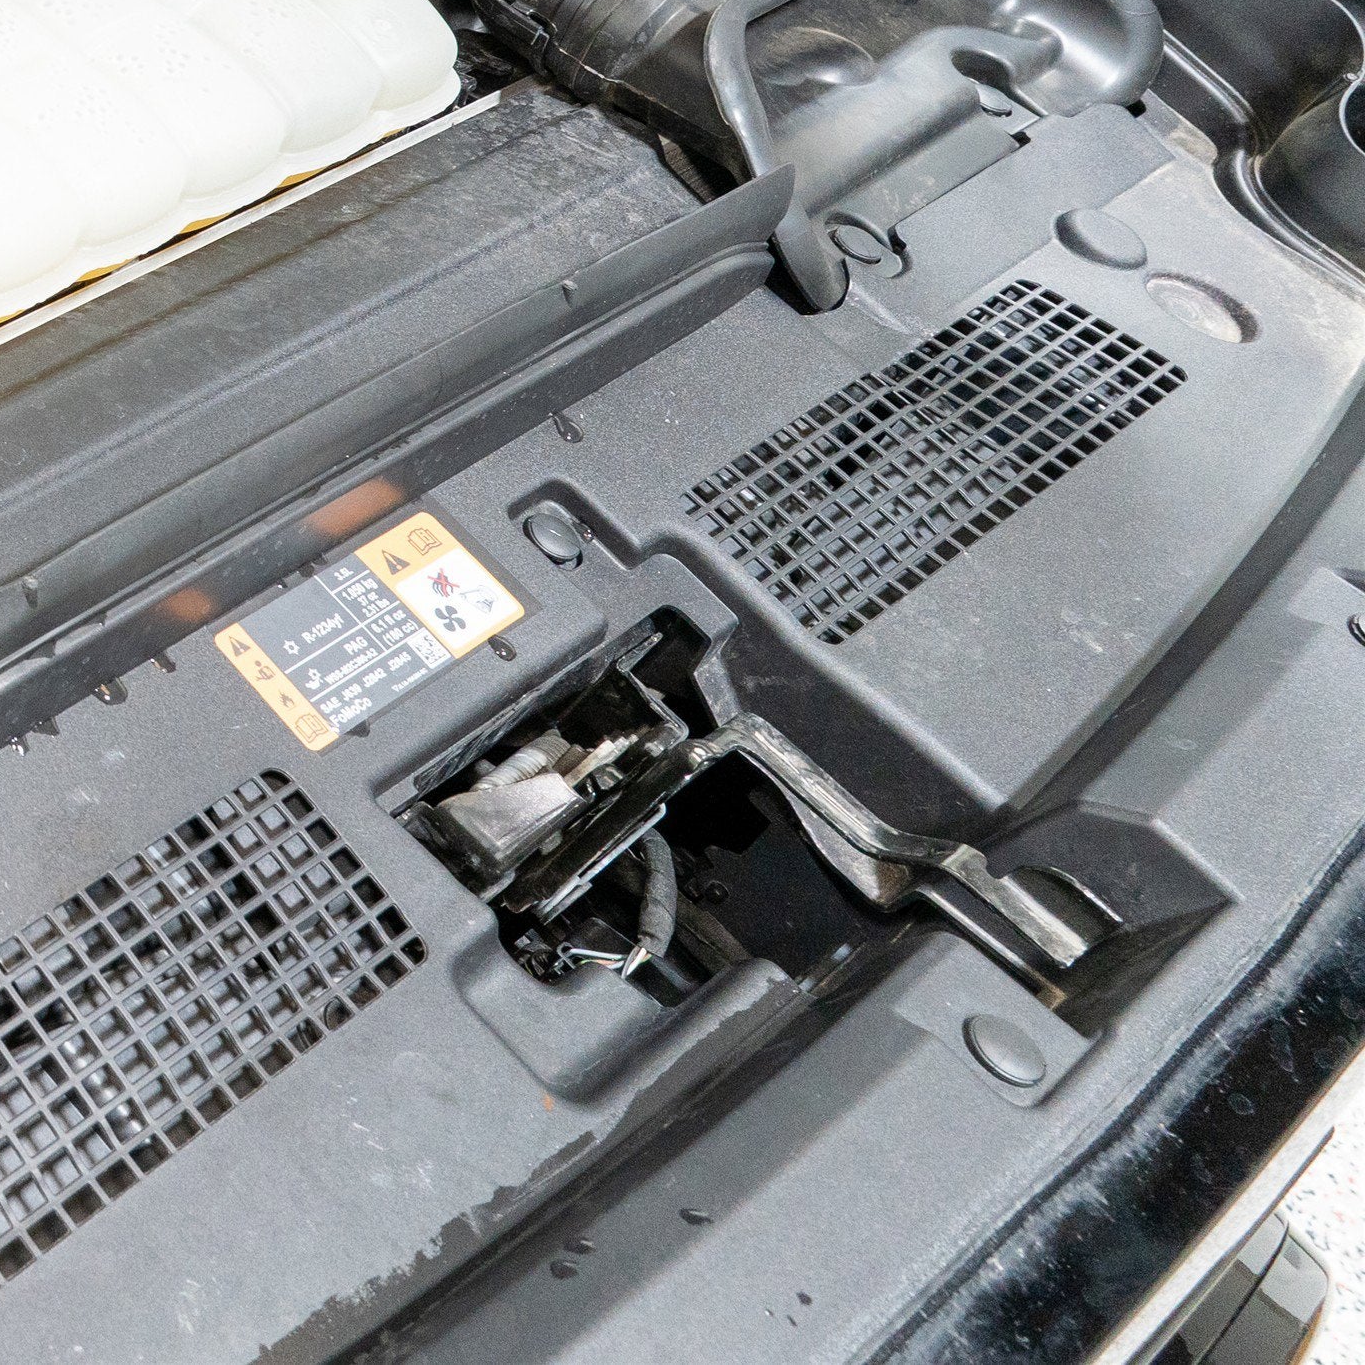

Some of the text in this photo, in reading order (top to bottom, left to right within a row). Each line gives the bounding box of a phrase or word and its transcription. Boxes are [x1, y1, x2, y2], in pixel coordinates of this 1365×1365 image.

[302, 614, 344, 644] R-1234yf
[343, 636, 368, 655] PAG
[320, 696, 340, 714] SAE
[331, 696, 374, 728] FoMoCo
